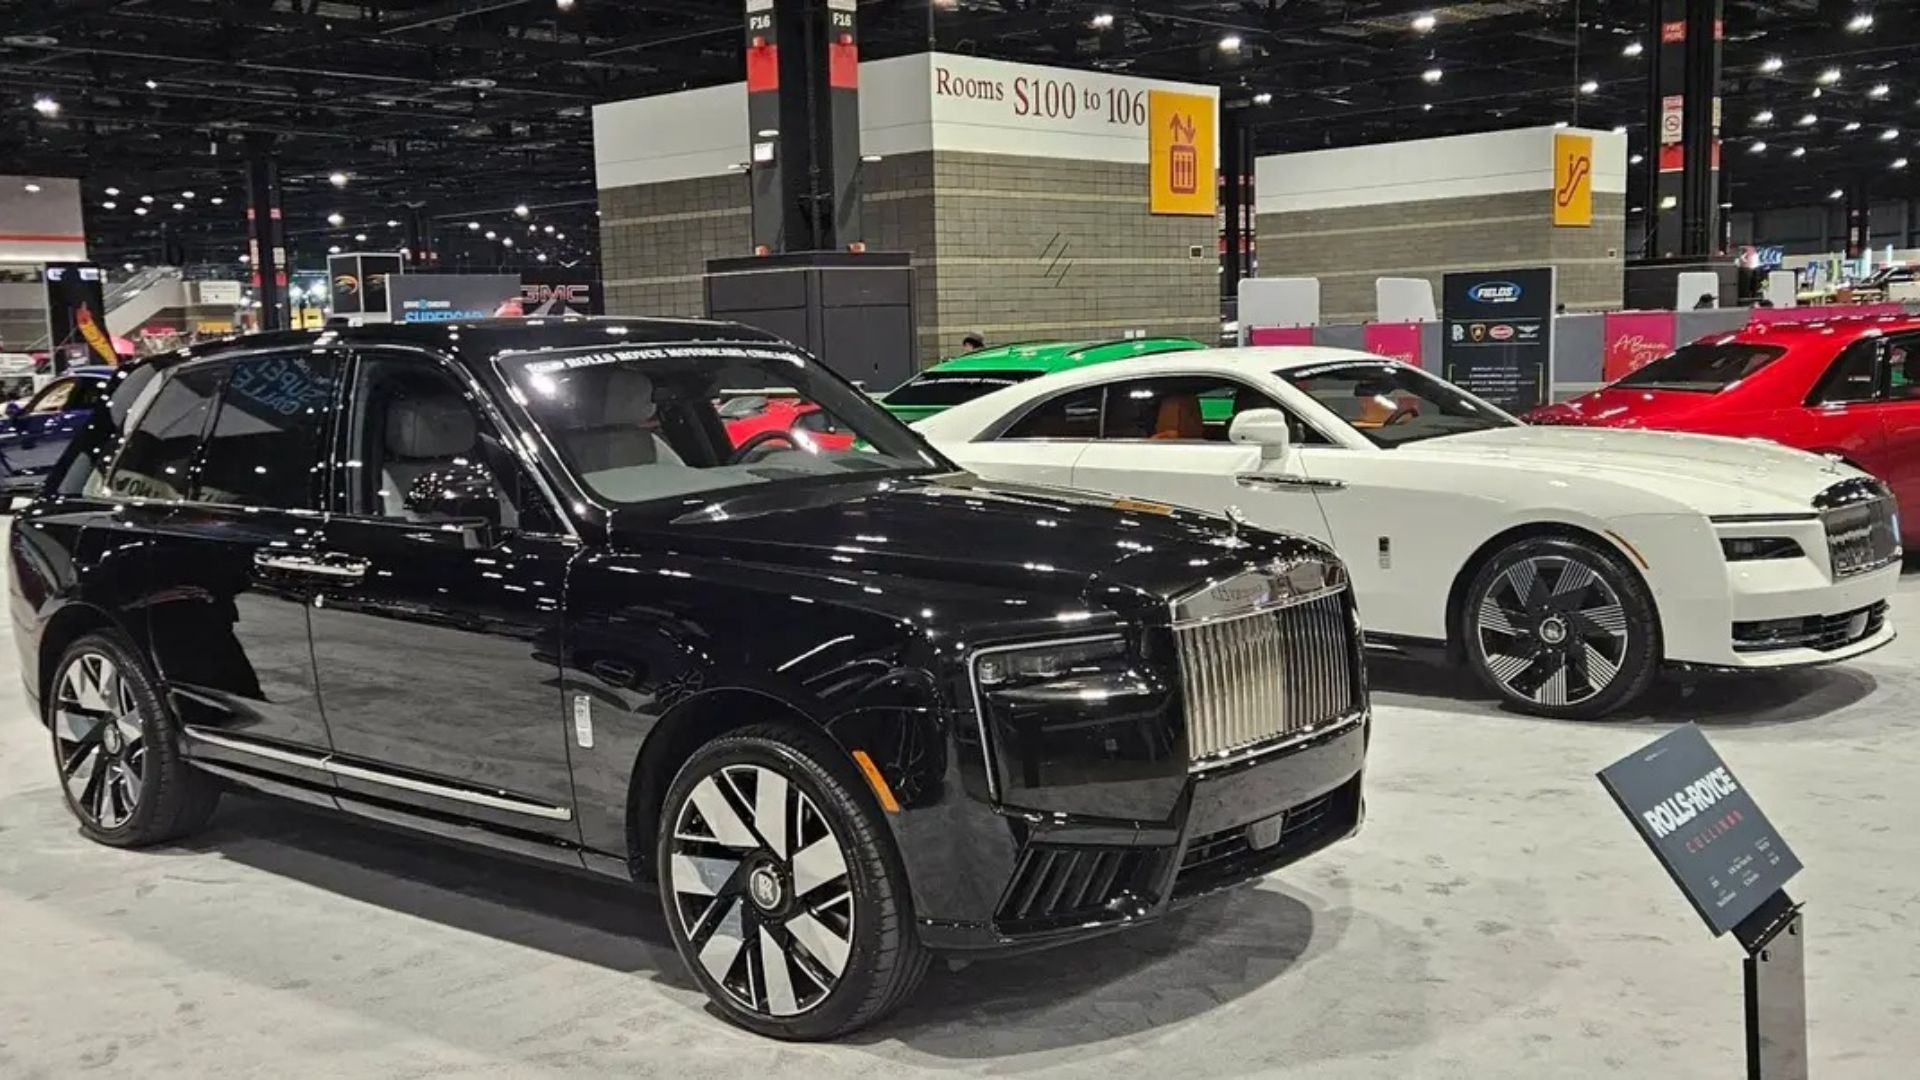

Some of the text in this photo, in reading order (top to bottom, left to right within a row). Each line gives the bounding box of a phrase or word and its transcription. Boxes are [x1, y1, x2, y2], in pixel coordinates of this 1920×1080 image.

[749, 14, 771, 30] F16
[832, 12, 852, 27] F16
[935, 67, 1146, 127] Rooms S100 to 106
[520, 284, 590, 303] GMC
[1477, 286, 1514, 298] FIELDS
[563, 352, 616, 370] ROLLS
[614, 347, 667, 362] ROYCE
[1642, 765, 1738, 839] ROLLS-ROYCE
[1685, 809, 1744, 854] CULLINAN
